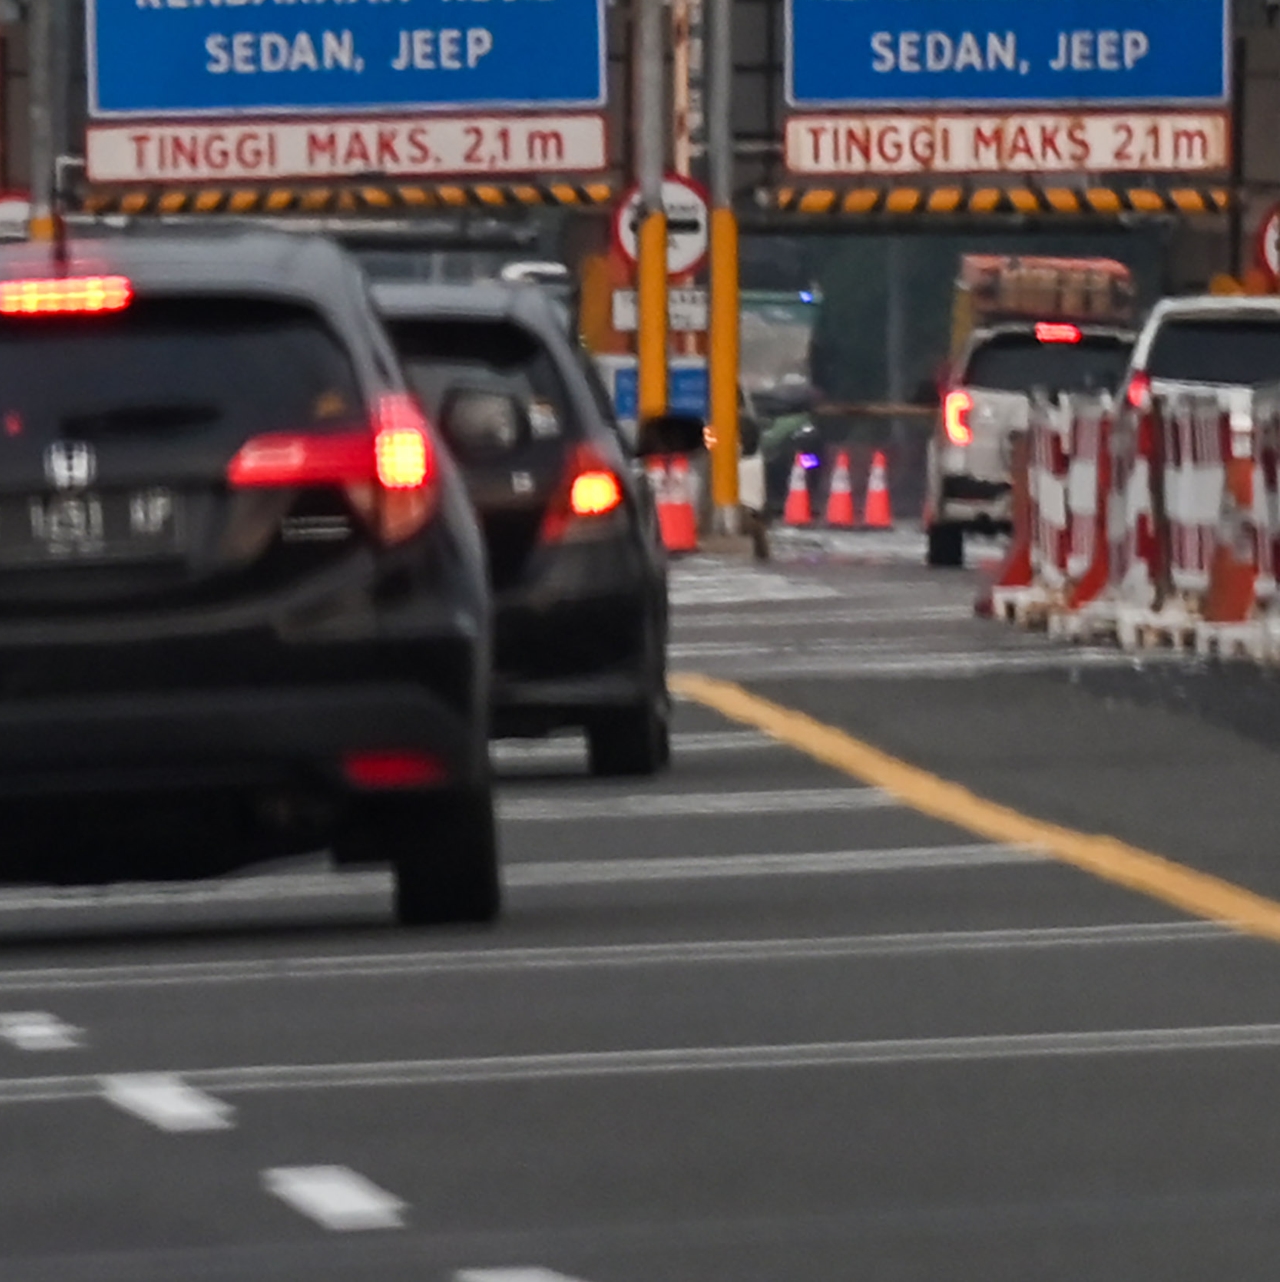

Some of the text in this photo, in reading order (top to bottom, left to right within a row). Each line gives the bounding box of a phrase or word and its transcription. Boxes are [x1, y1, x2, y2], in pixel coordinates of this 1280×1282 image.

[205, 27, 493, 74] SEDAN, JEEP
[870, 29, 1150, 75] SEDAN, JEEP
[129, 132, 277, 171] TINGGI
[807, 126, 950, 166] TINGGI
